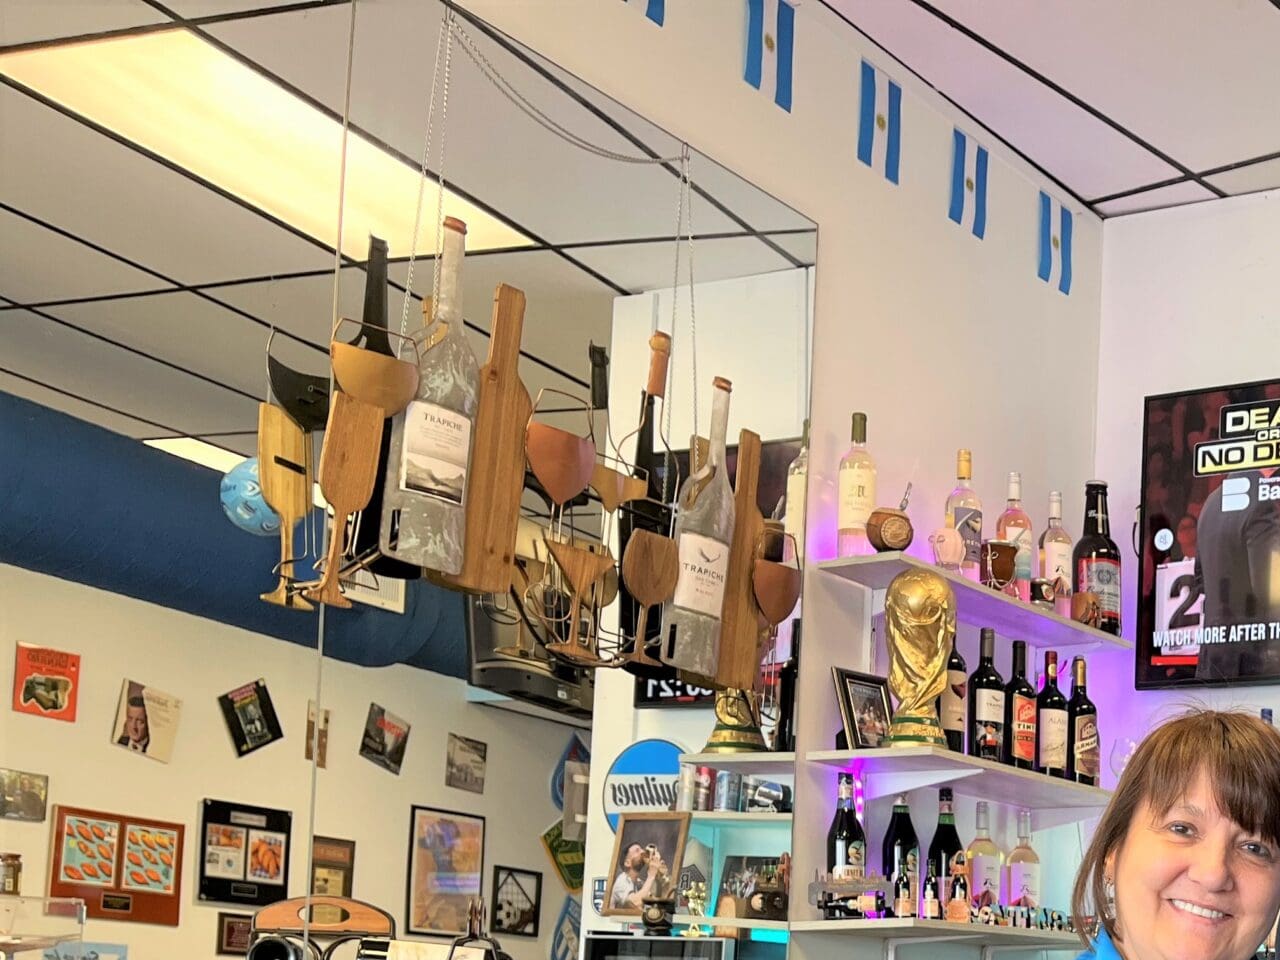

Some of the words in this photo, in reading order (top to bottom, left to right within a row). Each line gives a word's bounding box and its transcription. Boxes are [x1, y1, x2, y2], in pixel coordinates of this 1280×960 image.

[1257, 428, 1280, 441] OR
[1201, 446, 1245, 468] NO
[683, 562, 724, 583] TRAPICHE
[1152, 629, 1192, 648] WATCH
[1194, 626, 1227, 645] MORE
[1229, 624, 1266, 643] AFTER
